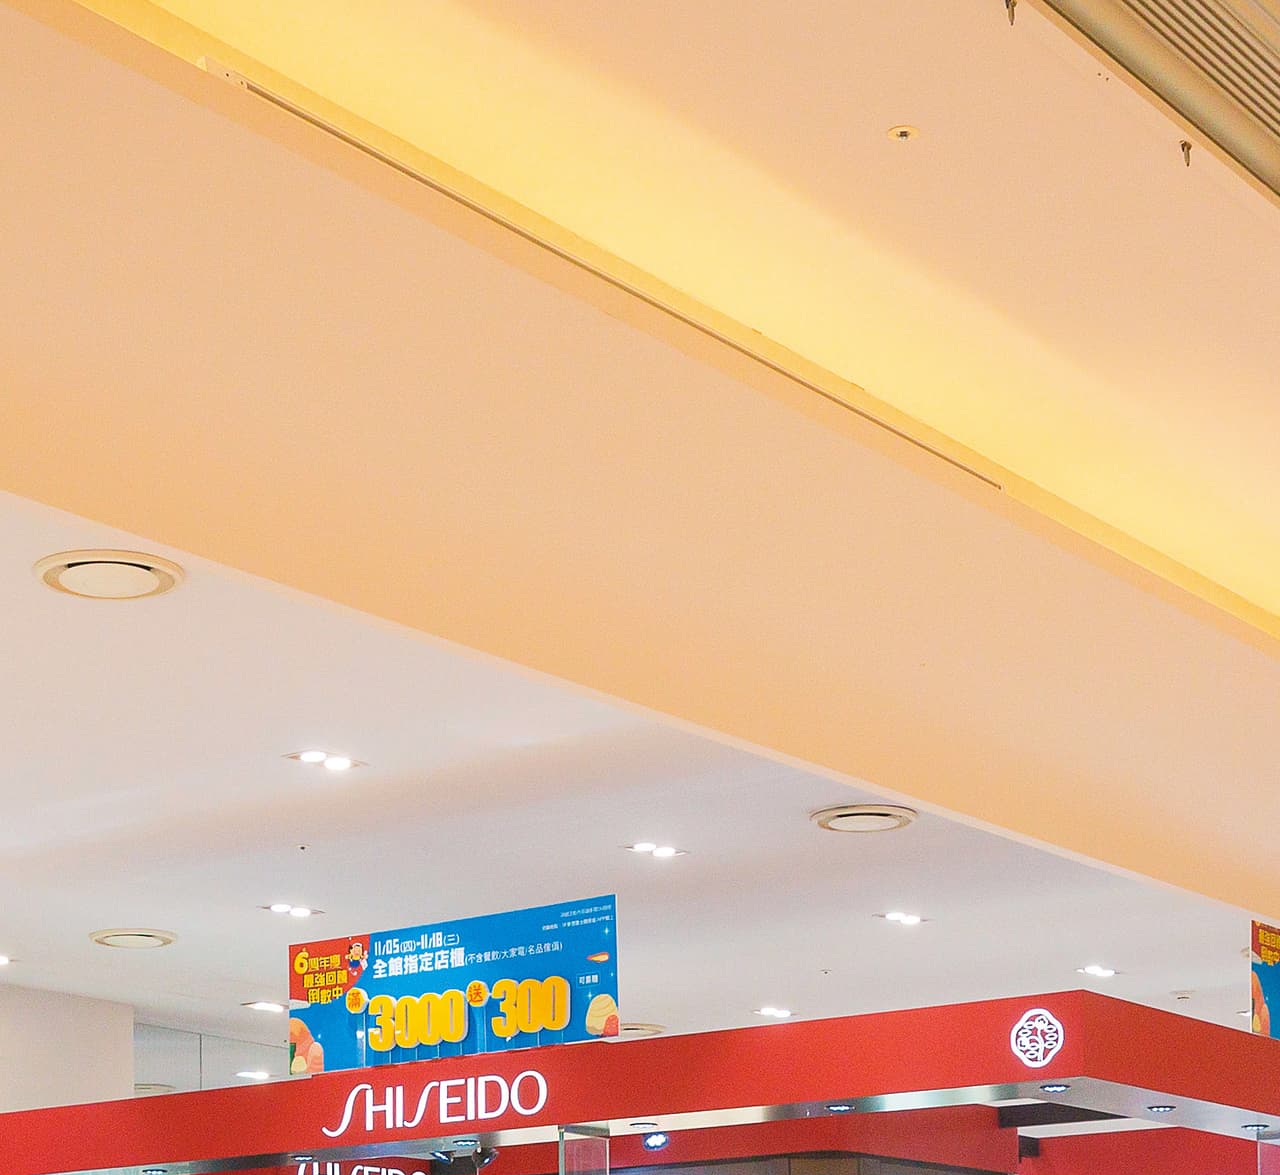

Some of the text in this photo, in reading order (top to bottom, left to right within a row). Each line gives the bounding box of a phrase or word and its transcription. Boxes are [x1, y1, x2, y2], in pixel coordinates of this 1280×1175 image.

[373, 947, 465, 979] 全館指定店櫃
[369, 990, 469, 1052] 3000
[492, 976, 571, 1039] 300
[321, 1070, 548, 1138] SHISEIDO
